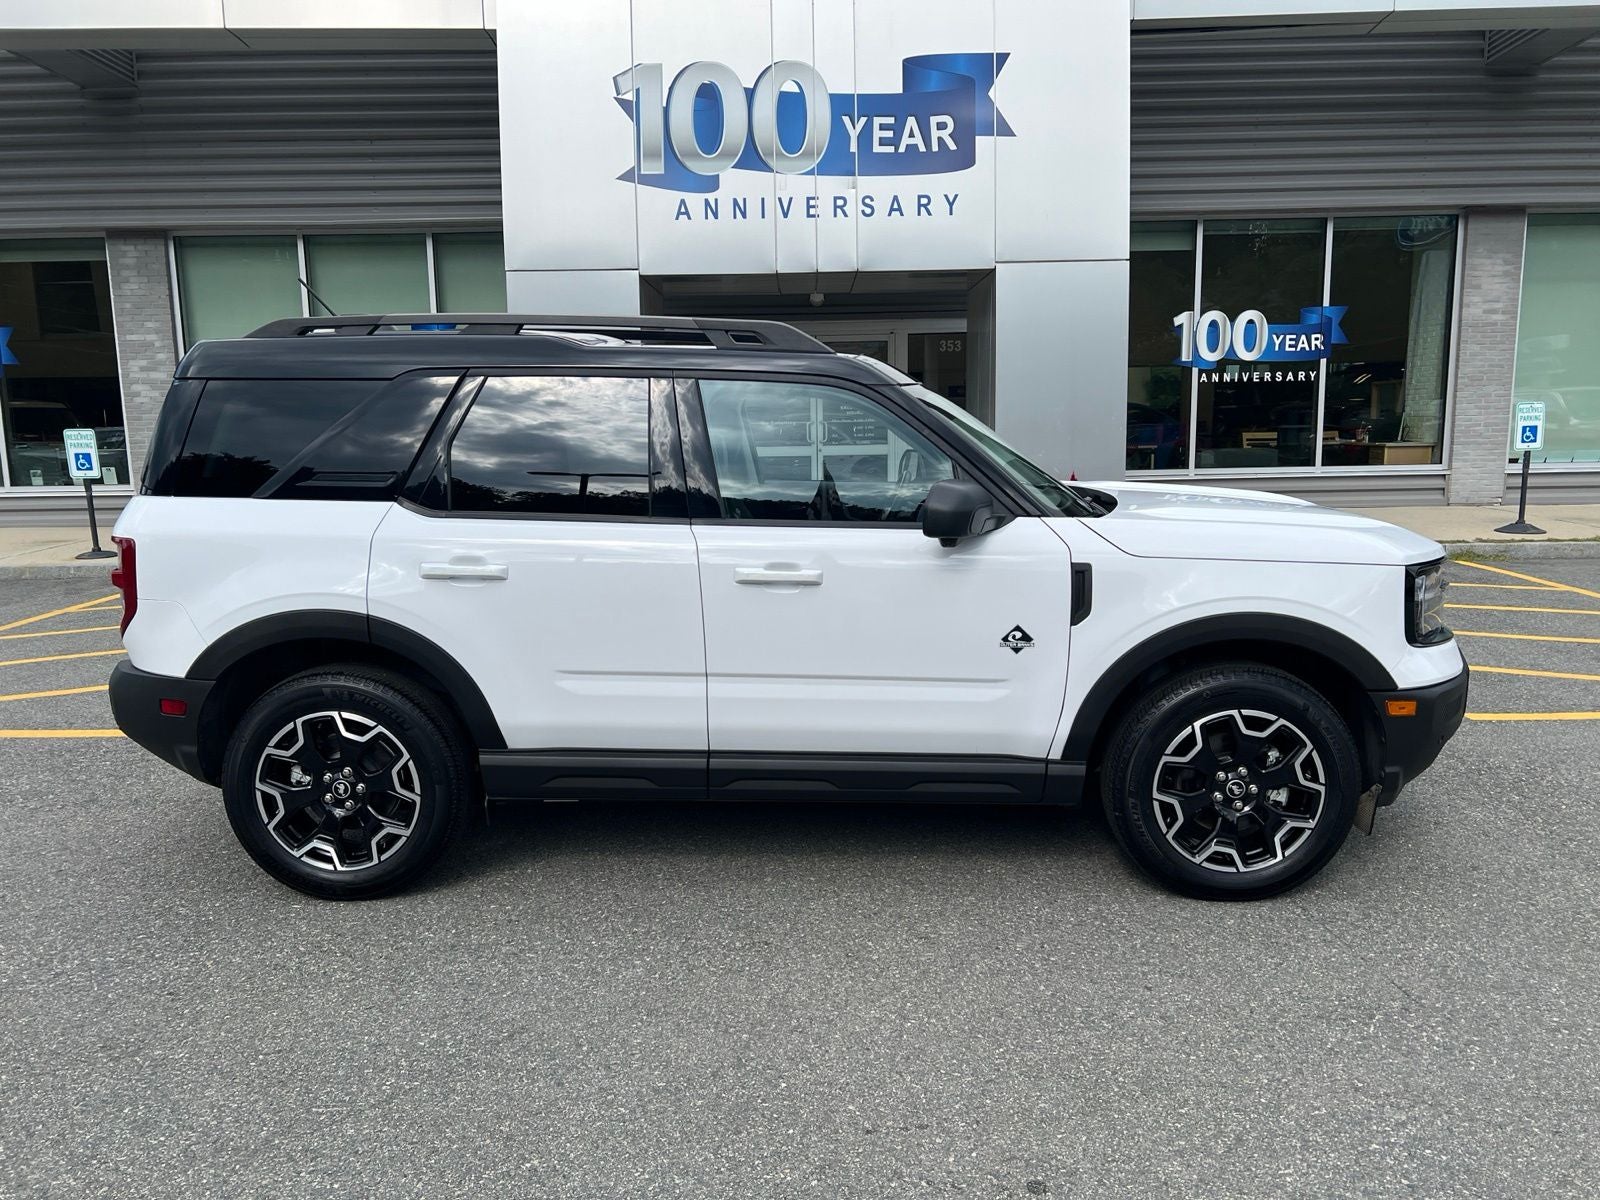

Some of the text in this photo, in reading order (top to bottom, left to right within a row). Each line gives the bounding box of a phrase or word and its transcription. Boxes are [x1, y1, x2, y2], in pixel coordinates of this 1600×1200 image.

[613, 60, 958, 175] 100 YEAR
[675, 193, 960, 221] ANNIVERSARY
[939, 340, 962, 352] 353
[1173, 310, 1325, 362] 100 YEAR
[1200, 371, 1317, 383] ANNIVERSARY
